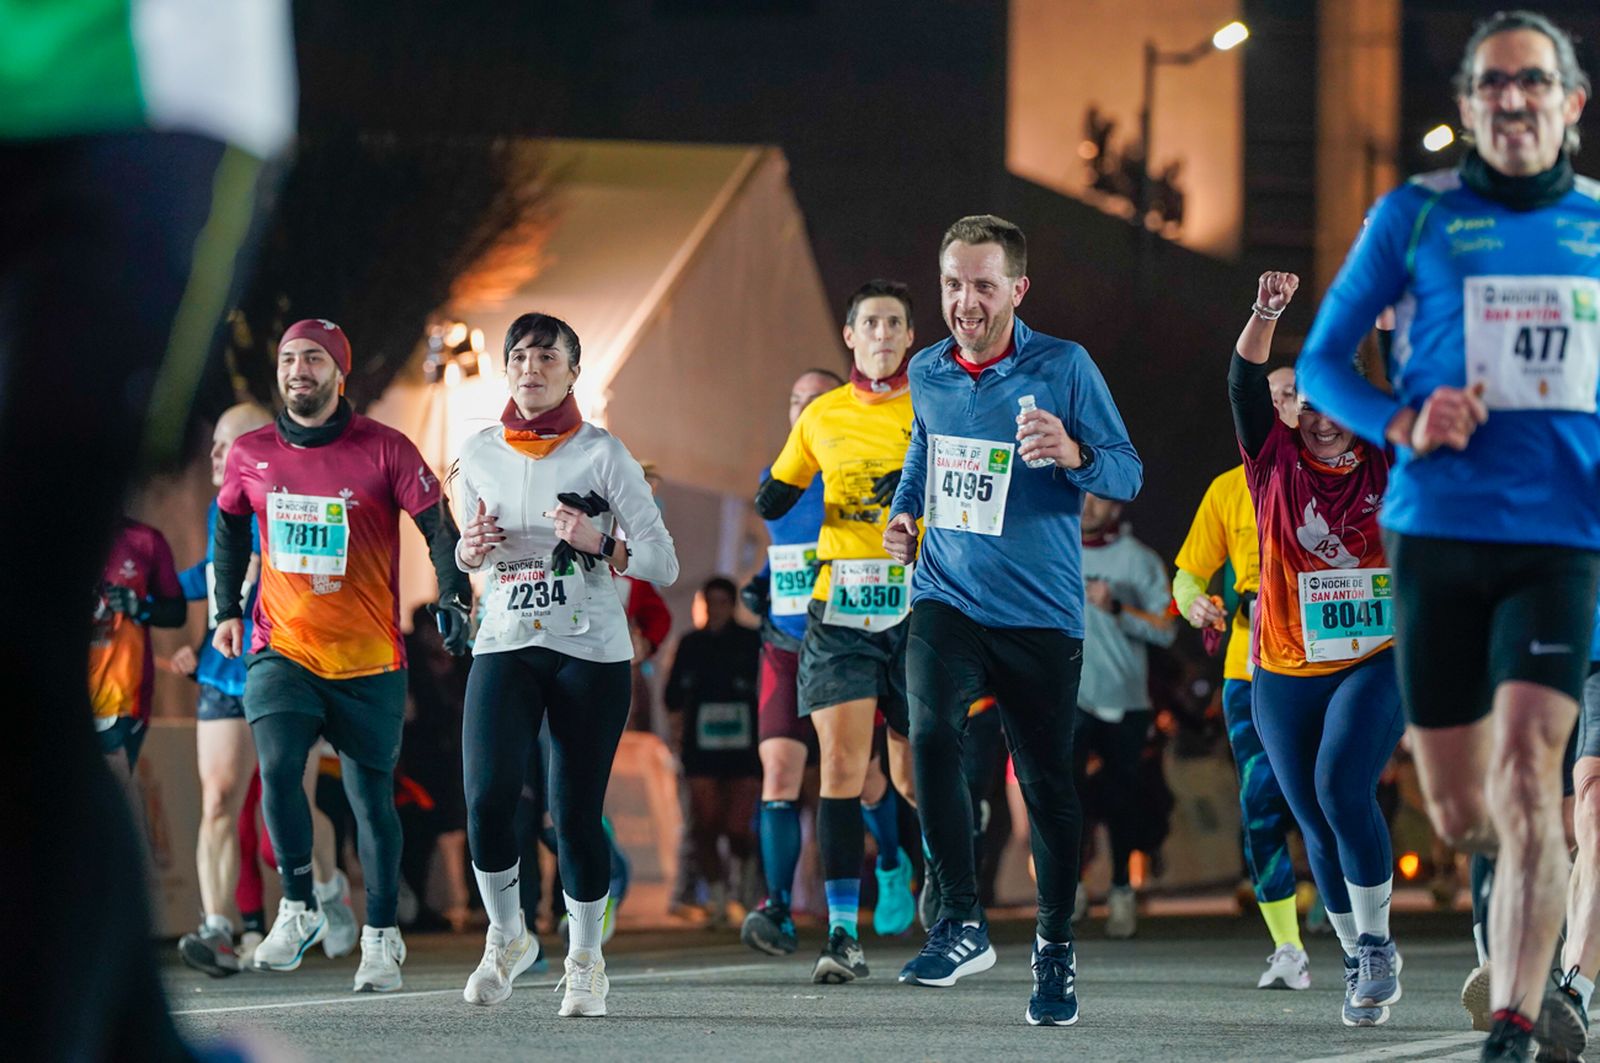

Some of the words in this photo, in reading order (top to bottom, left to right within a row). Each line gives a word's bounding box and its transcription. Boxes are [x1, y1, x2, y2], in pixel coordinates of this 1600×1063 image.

[1514, 325, 1570, 362] 477
[942, 470, 994, 502] 4795
[285, 522, 328, 548] 7811
[1313, 539, 1339, 559] 43
[508, 560, 533, 572] NOCHE
[535, 560, 543, 569] DE
[775, 568, 816, 590] 2992
[1321, 579, 1350, 589] NOCHE
[1352, 578, 1363, 588] DE
[507, 579, 567, 611] 2234
[840, 585, 900, 608] 13350
[1311, 591, 1330, 602] SAN
[1322, 600, 1384, 630] 8041
